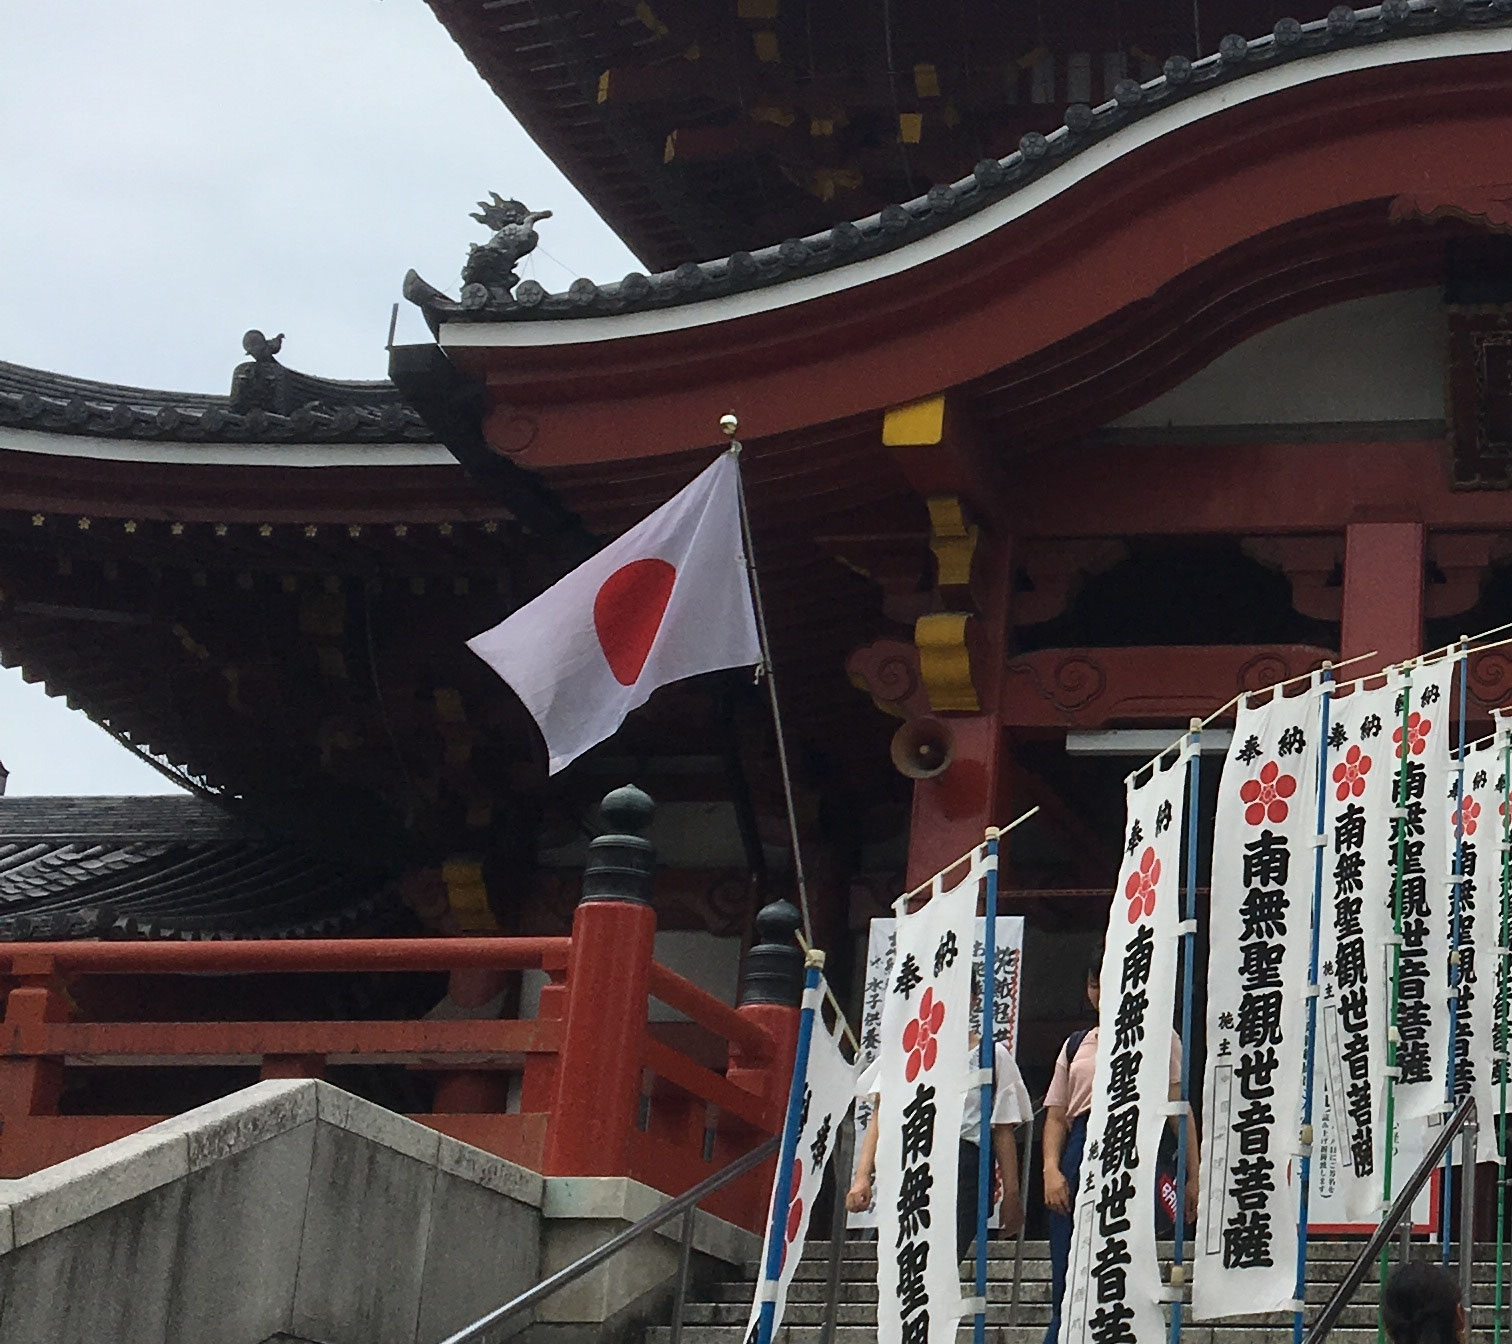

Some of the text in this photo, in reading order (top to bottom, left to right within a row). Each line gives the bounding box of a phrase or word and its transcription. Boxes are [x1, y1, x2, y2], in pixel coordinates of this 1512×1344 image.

[1235, 725, 1306, 766] 奉納
[1328, 713, 1382, 752] 奉納
[1126, 799, 1172, 857] 奉納
[893, 930, 958, 1001] 奉納
[1216, 1011, 1235, 1057] 施主
[1222, 829, 1291, 1270] 南無聖観世音菩薩
